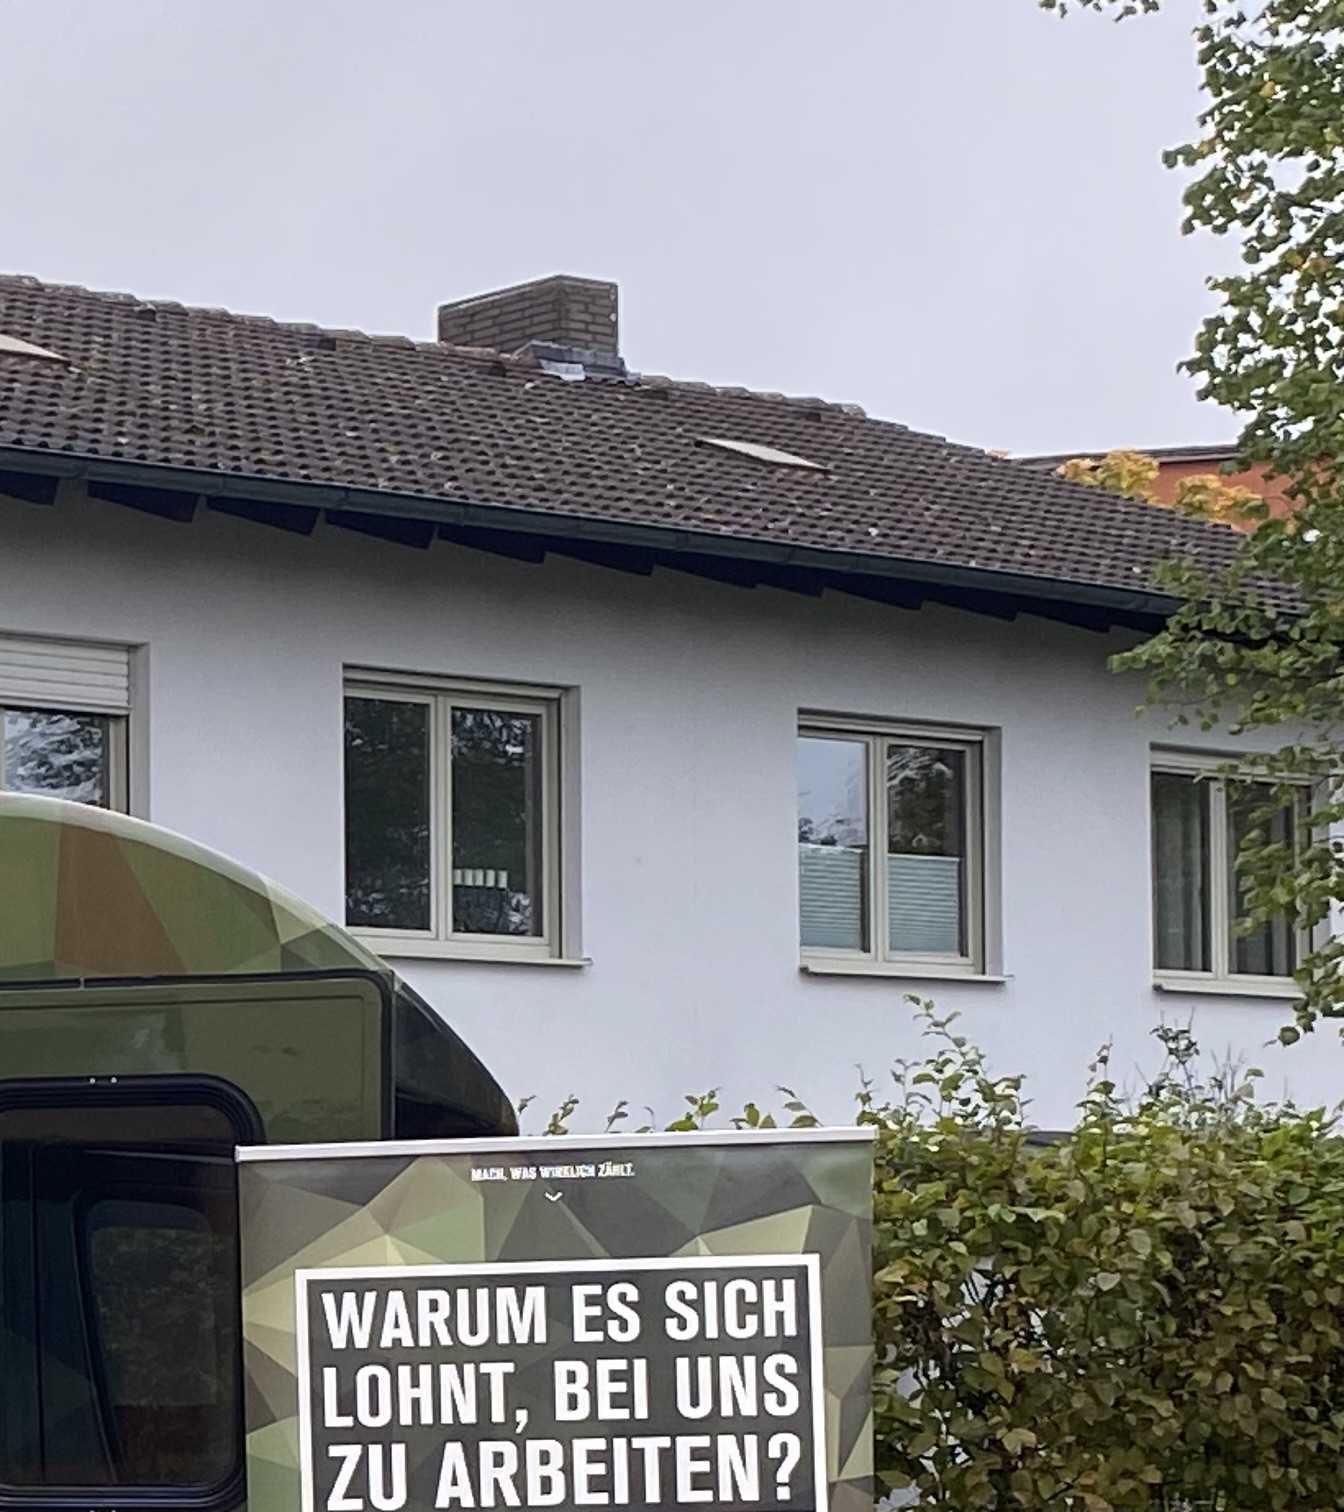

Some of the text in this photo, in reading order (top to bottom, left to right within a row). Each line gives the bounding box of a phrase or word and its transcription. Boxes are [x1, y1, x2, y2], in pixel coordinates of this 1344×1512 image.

[509, 1166, 537, 1180] WAS
[320, 1278, 798, 1349] WARUM ES SICH
[322, 1353, 800, 1434] LOHNT, BEI UNS
[326, 1432, 802, 1512] ZU ARBEITEN?
